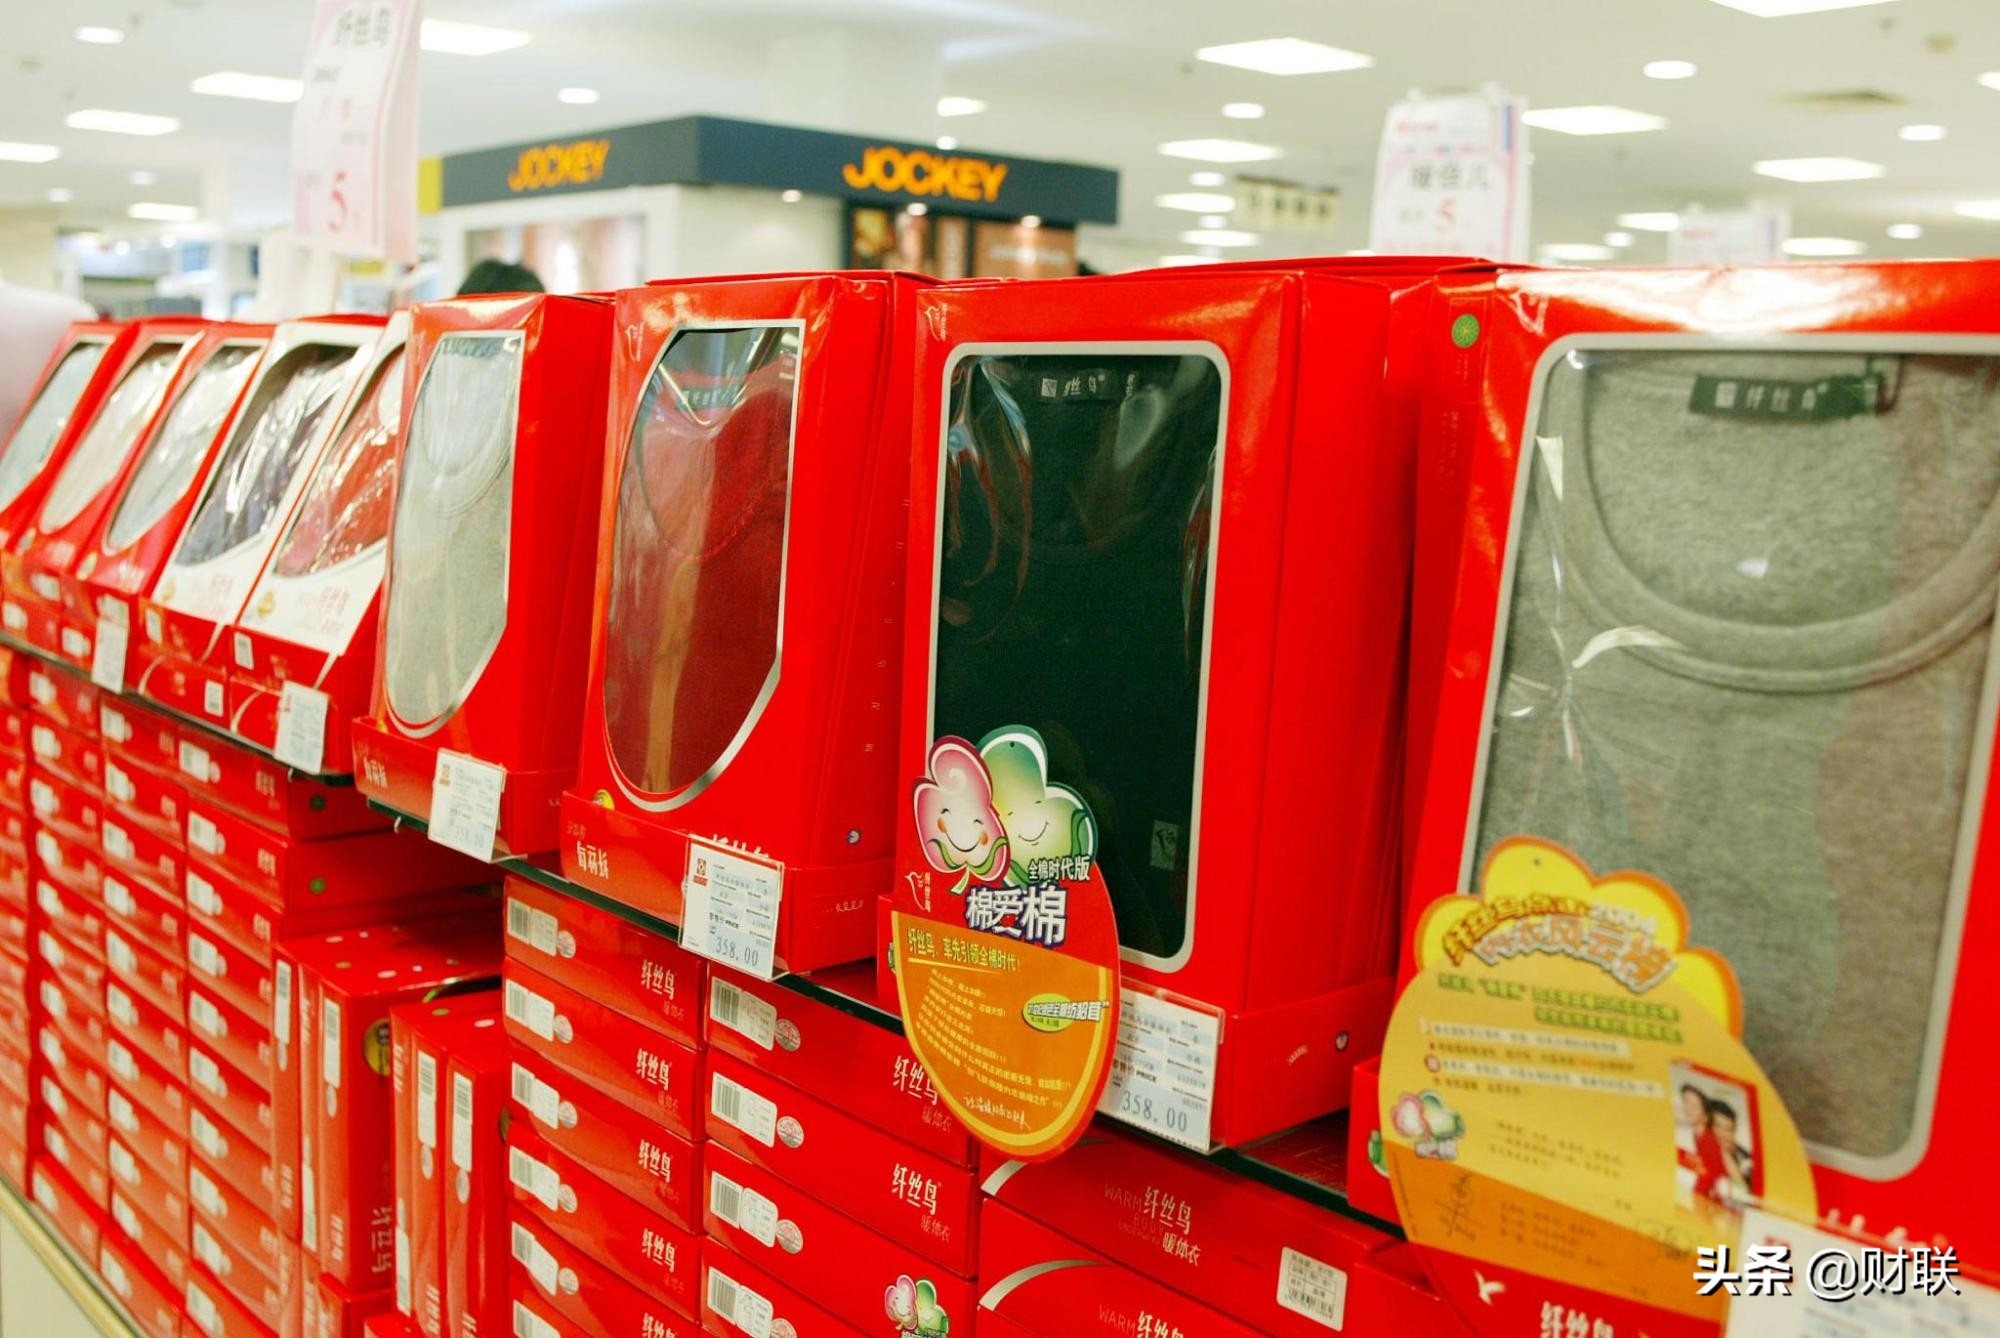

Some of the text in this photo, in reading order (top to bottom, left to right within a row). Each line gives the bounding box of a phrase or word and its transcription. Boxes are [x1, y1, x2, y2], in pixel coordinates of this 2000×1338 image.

[507, 139, 611, 192] JOCKEY
[842, 146, 1009, 202] JOCKEY
[1028, 856, 1090, 881] 全棉时代版
[966, 885, 1067, 946] 棉爱棉
[715, 936, 759, 967] 358.00
[641, 959, 676, 1001] 纤丝鸟
[636, 1048, 672, 1091] 纤丝鸟
[1122, 1089, 1188, 1133] 358.00
[638, 1139, 672, 1183] 纤丝鸟
[892, 1163, 938, 1215] 纤丝鸟
[1104, 1182, 1143, 1212] WARM
[1143, 1186, 1192, 1235] 纤丝鸟
[641, 1228, 677, 1273] 纤丝鸟
[1162, 1232, 1201, 1267] 暖体衣
